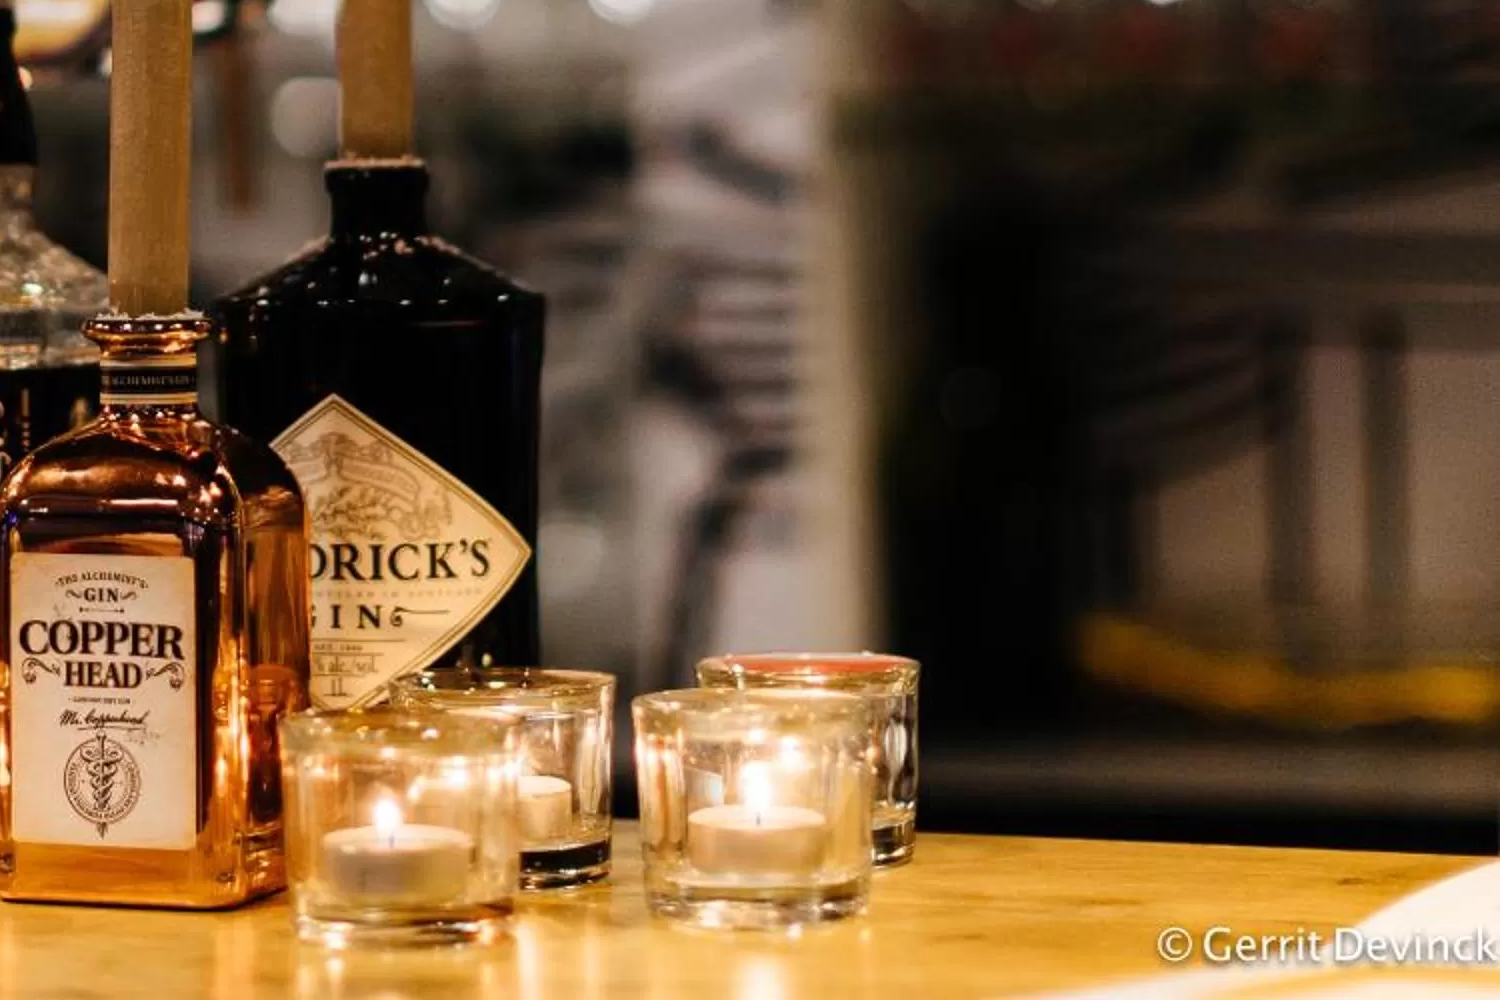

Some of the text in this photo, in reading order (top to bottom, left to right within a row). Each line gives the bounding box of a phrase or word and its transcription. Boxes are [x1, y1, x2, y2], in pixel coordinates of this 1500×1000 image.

[83, 587, 119, 603] GIN
[19, 618, 185, 661] COPPER
[63, 659, 143, 690] HEAD
